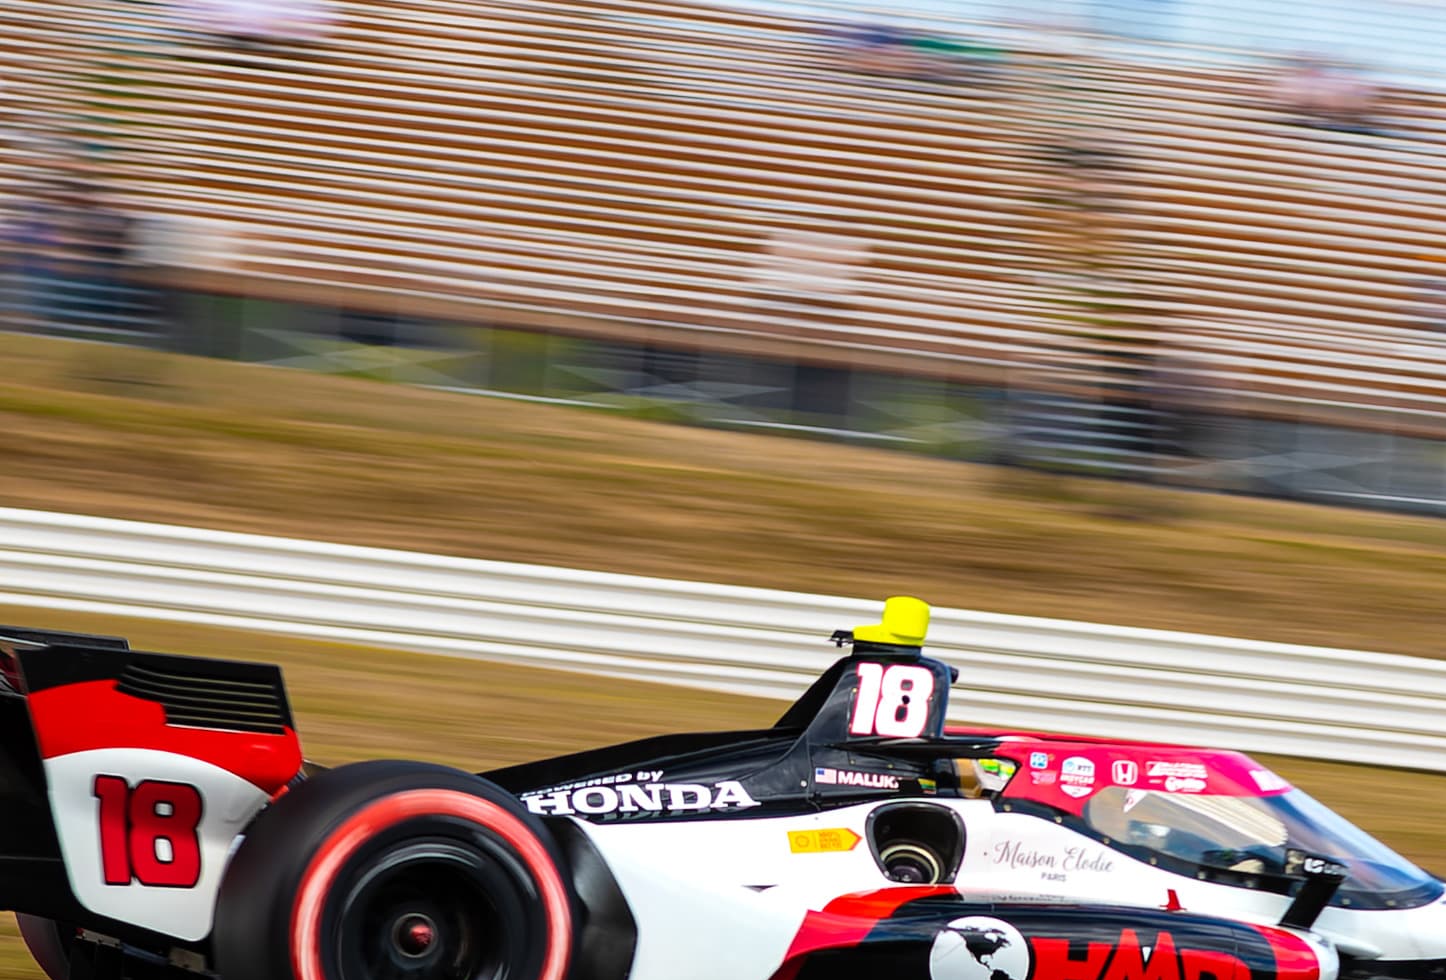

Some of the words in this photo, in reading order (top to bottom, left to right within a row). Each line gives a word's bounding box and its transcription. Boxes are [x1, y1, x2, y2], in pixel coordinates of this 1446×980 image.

[849, 661, 934, 738] 18
[636, 770, 663, 782] by
[519, 780, 761, 816] HONDA
[93, 773, 205, 889] 18
[993, 840, 1056, 869] Maison
[1062, 845, 1115, 872] Elodie
